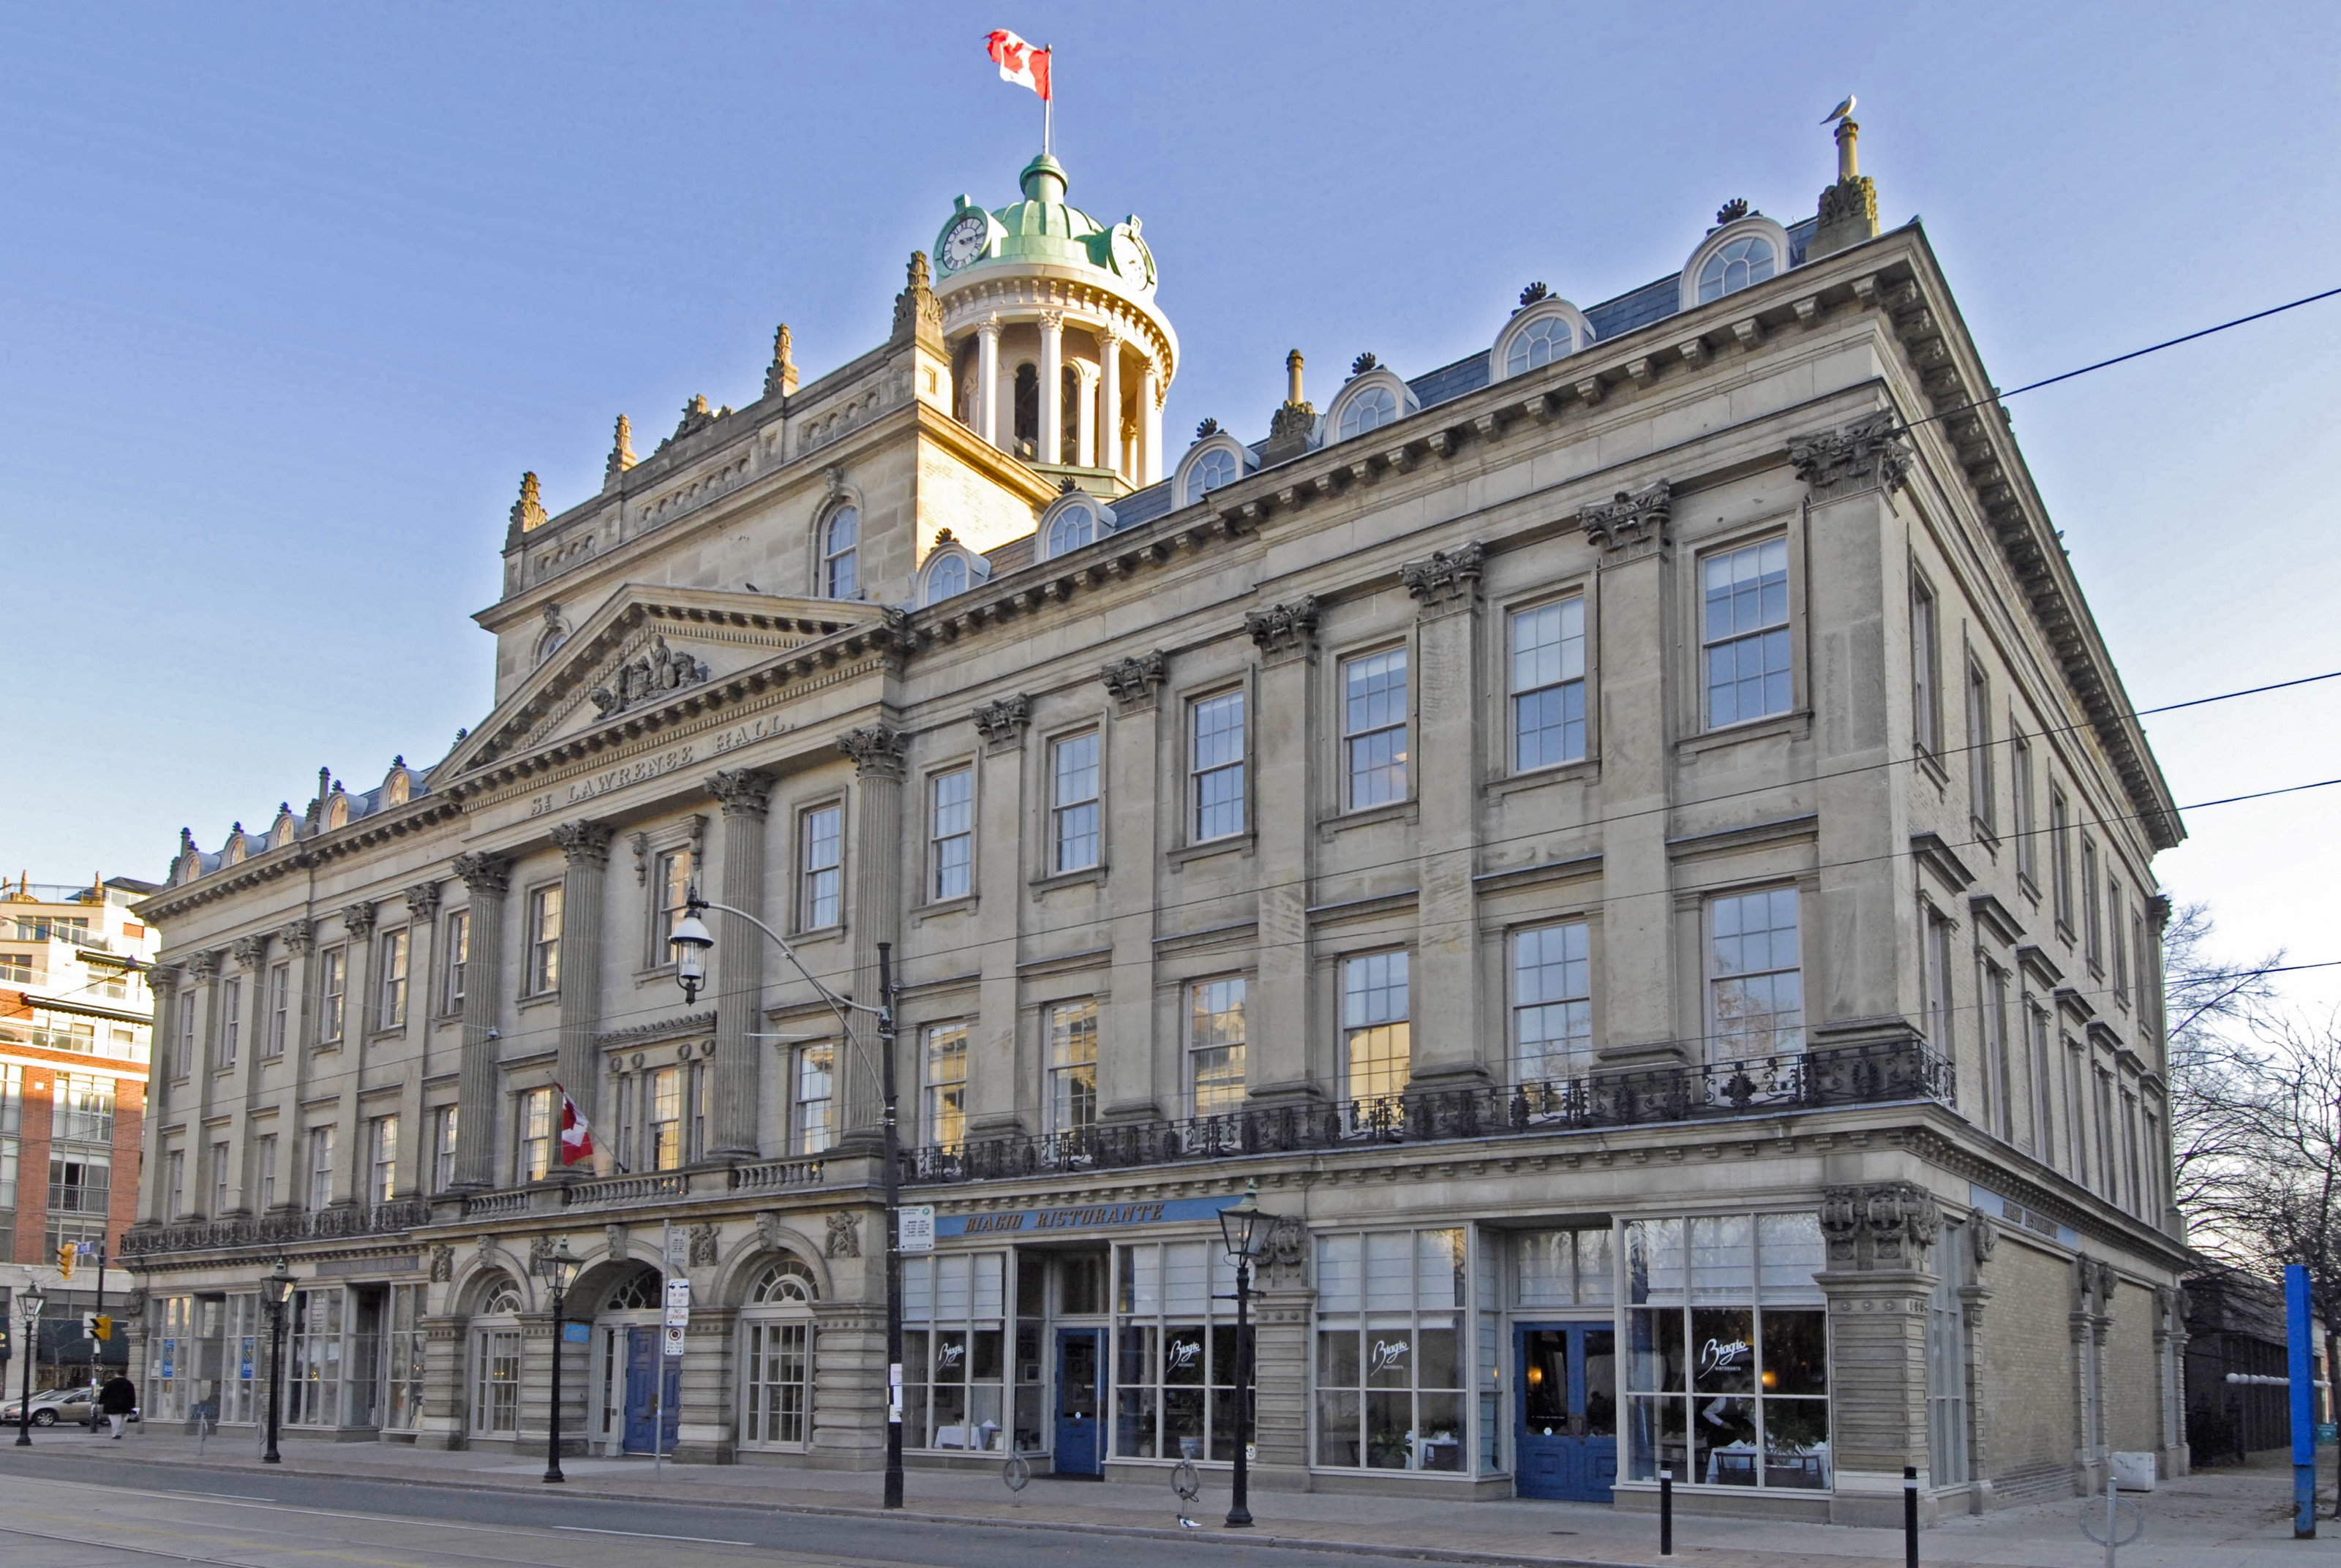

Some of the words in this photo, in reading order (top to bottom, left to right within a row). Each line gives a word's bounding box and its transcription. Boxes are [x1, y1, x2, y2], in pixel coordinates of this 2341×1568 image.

[567, 745, 694, 804] LAWRENCE
[964, 1214, 1023, 1234] BIAGIO
[1034, 1203, 1165, 1229] RISTORANTE
[937, 1343, 964, 1372] Biagio
[1167, 1340, 1201, 1373] Biagio
[1370, 1340, 1410, 1376] Biagio
[1698, 1338, 1749, 1379] Biagio
